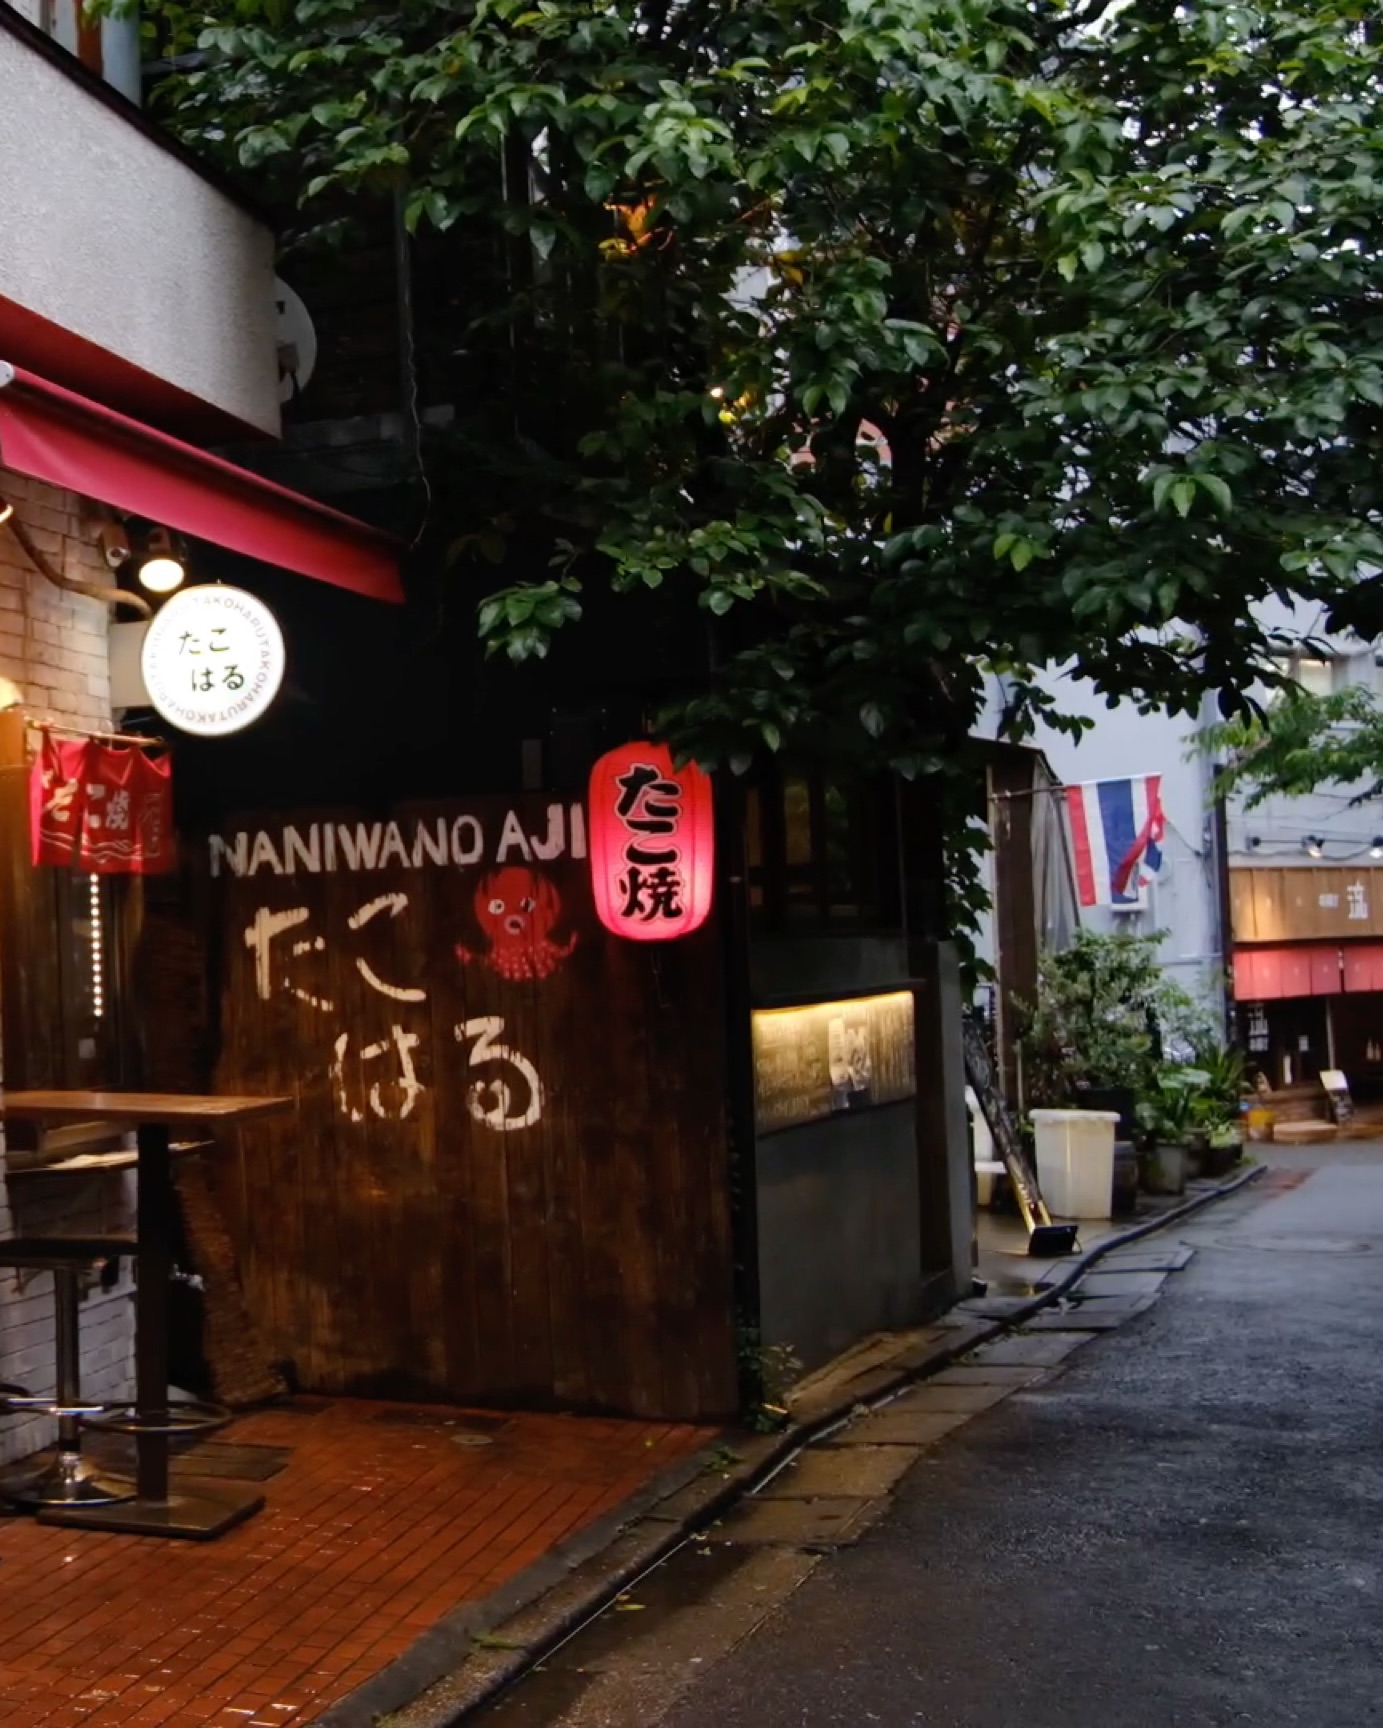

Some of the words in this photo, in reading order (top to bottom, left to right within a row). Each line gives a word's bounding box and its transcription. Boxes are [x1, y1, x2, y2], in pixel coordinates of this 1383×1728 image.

[178, 627, 231, 656] たこ
[191, 663, 245, 692] はる
[208, 815, 484, 877] NANIWANO
[497, 803, 587, 863] AJI
[615, 764, 683, 922] たこ焼
[244, 892, 426, 1011] たこ
[329, 1015, 545, 1132] はる
